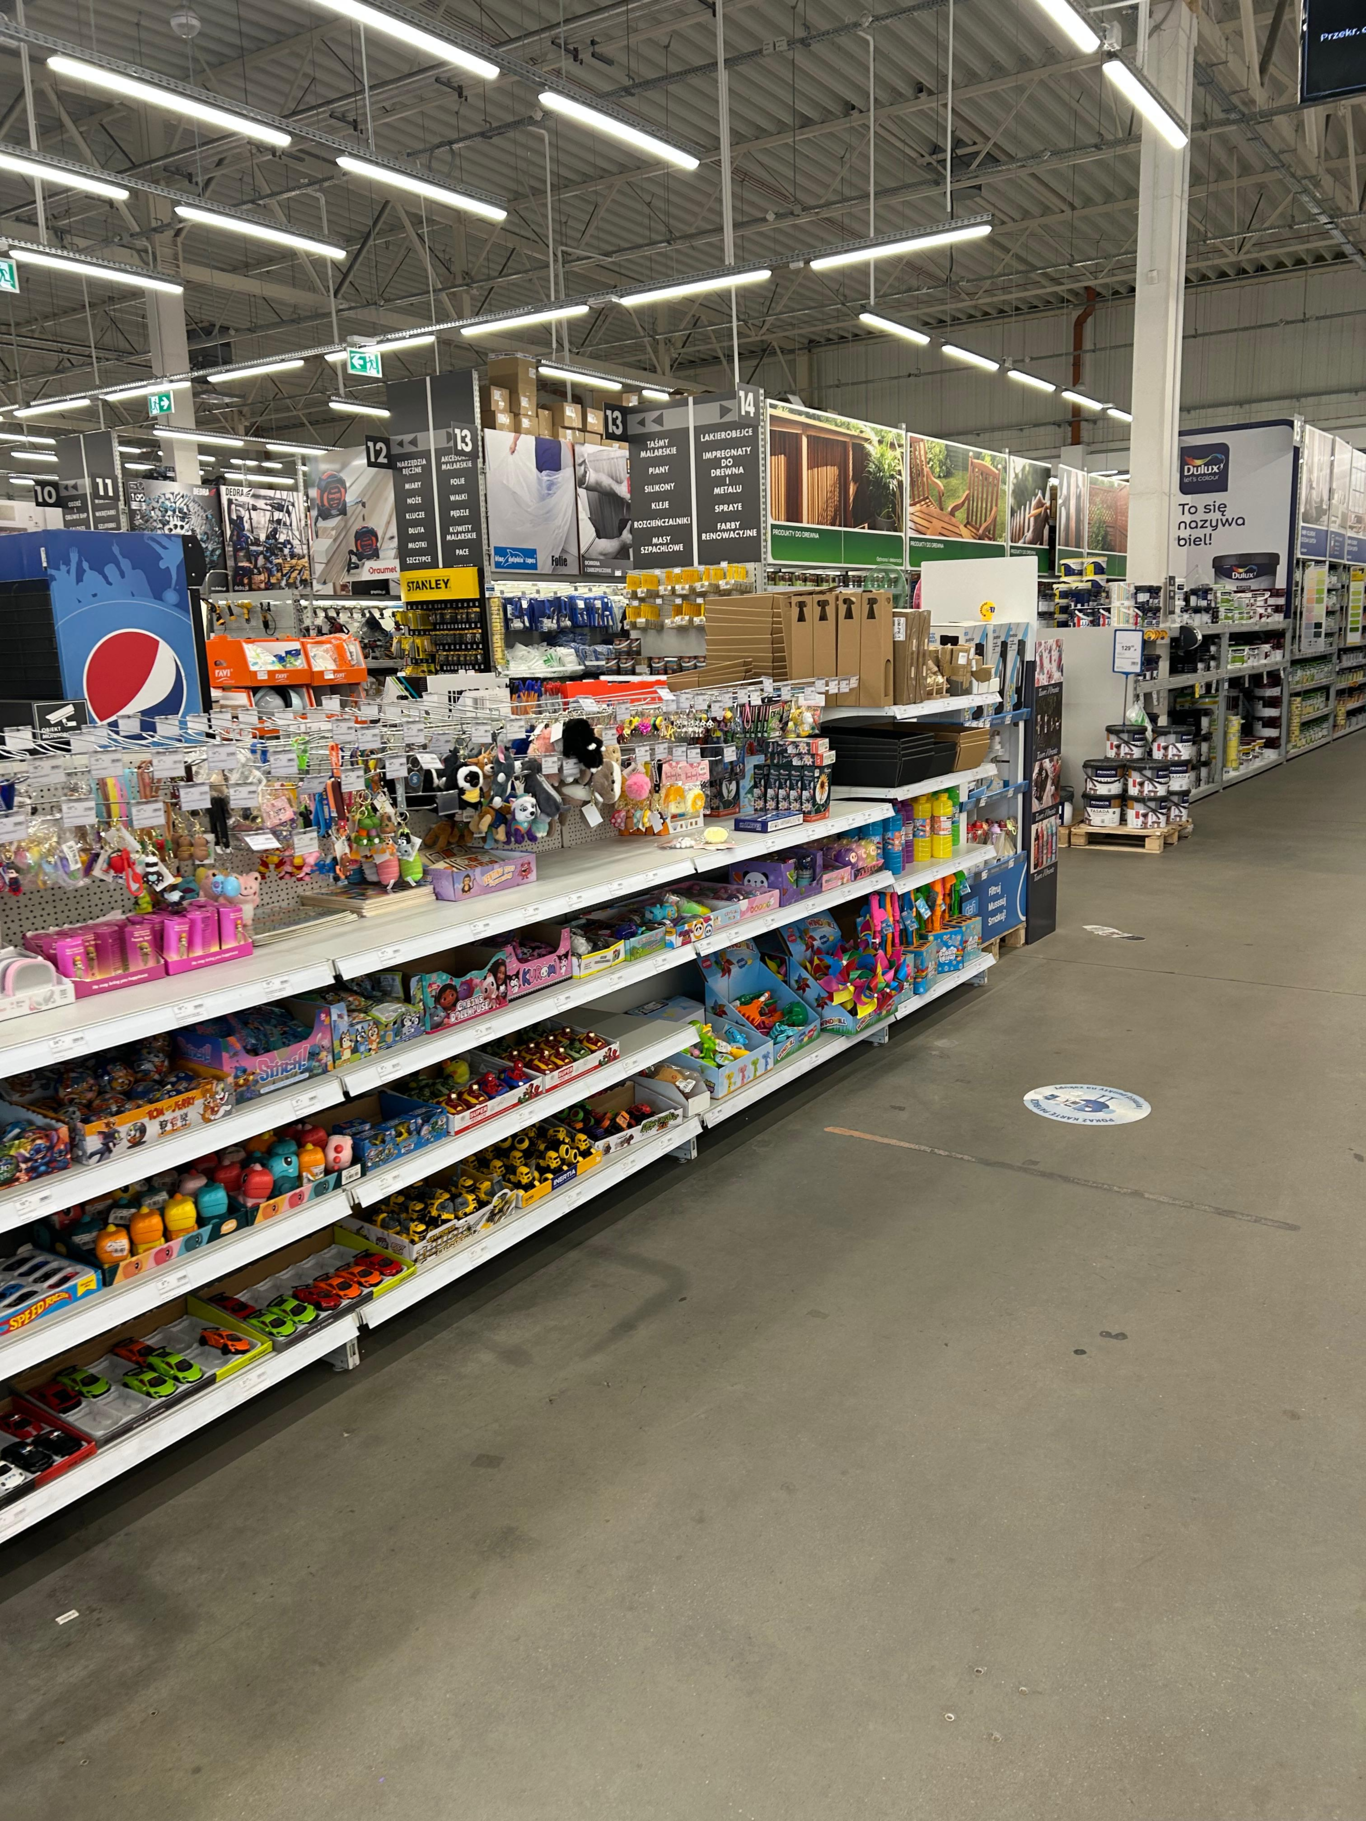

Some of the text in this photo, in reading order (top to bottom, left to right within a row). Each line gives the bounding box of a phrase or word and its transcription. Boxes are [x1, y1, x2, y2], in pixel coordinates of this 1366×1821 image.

[738, 390, 755, 417] 14
[605, 409, 623, 435] 13
[700, 428, 753, 442] LAKIEROBEJCE
[454, 428, 472, 453] 13
[647, 438, 669, 448] TAŚMY
[367, 440, 388, 464] 12
[640, 446, 677, 458] MALARSKIE
[702, 447, 751, 460] IMPREGNATY
[441, 461, 472, 471] MALARSKIE
[721, 458, 733, 466] DO
[648, 465, 669, 475] PIANY
[710, 466, 745, 477] DREWNA
[1184, 464, 1220, 476] Dulux
[1183, 474, 1220, 483] let's colour
[95, 477, 114, 497] 11
[404, 481, 422, 489] MIARY
[644, 483, 675, 493] SILIKONY
[713, 485, 742, 495] METALU
[34, 485, 57, 504] 10
[192, 487, 210, 496] DEDRA
[225, 487, 244, 497] DEDRA
[406, 496, 422, 504] NOŻE
[449, 493, 468, 501] WAŁKI
[651, 501, 669, 510] KLEJE
[714, 503, 743, 513] SPRAYE
[1178, 501, 1228, 517] To się
[405, 511, 426, 519] KLUCZE
[450, 509, 469, 518] PĘDZLE
[633, 517, 691, 529] ROZCIEŃCZALNIKI
[717, 521, 741, 530] FARBY
[1177, 516, 1246, 532] nazywa
[408, 526, 425, 535] DŁUTA
[449, 525, 472, 533] KUWETY
[772, 529, 820, 539] PRODUKTY DO DREWNA
[446, 532, 477, 541] MALARSKIE
[701, 529, 758, 541] RENOWACYJNE
[1176, 533, 1213, 547] biel!
[407, 541, 428, 549] MŁOTKI
[652, 536, 671, 545] MASY
[640, 543, 684, 554] SZPACHLOWE
[406, 556, 431, 564] SZCZYPCE
[551, 555, 568, 567] Folie
[368, 565, 398, 575] Draumet
[1232, 571, 1255, 579] Dulux
[406, 578, 451, 592] STANLEY
[988, 882, 1002, 897] Filtruj
[965, 900, 976, 915] dafi
[558, 1066, 574, 1079] SUPER
[146, 1107, 166, 1121] TOM
[171, 1095, 196, 1113] JERRY
[469, 1105, 488, 1120] SUPER
[553, 1169, 576, 1186] INERTIA
[8, 1300, 45, 1331] SPEED
